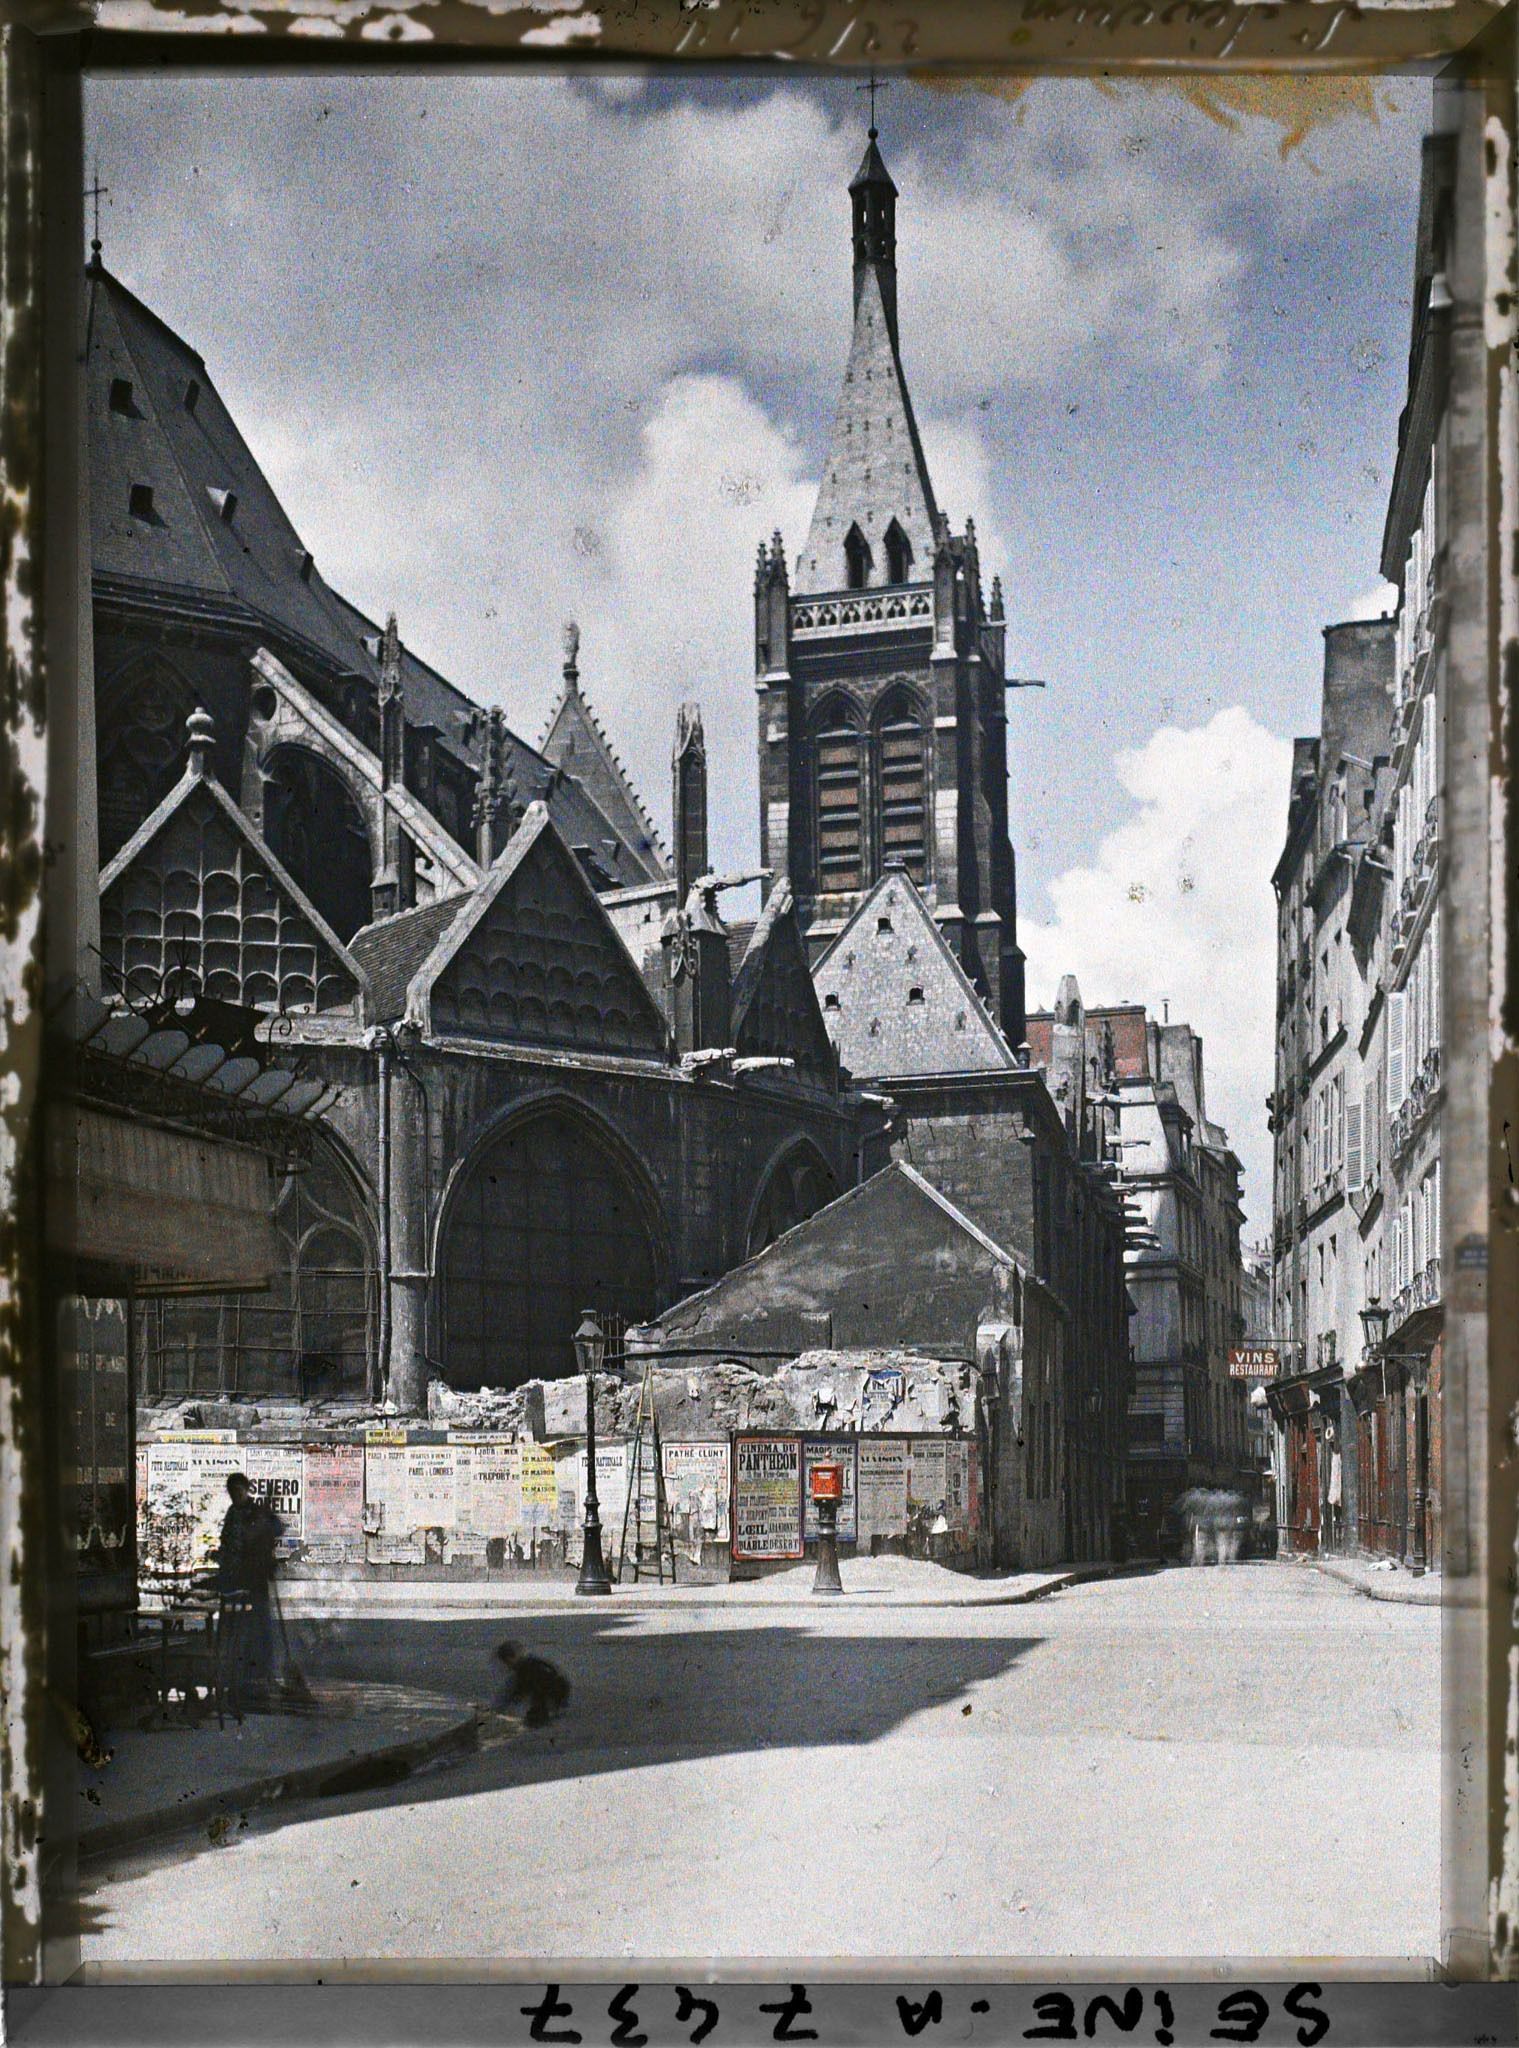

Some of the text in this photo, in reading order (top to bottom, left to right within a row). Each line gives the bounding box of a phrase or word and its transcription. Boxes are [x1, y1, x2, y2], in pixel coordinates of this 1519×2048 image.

[1235, 1352, 1275, 1364] VINS
[1229, 1363, 1279, 1376] RESTAURANT
[740, 1444, 796, 1454] CINEMA DU
[248, 1478, 299, 1496] SEVERO
[758, 1983, 820, 2041] 7
[896, 1989, 944, 2037] A
